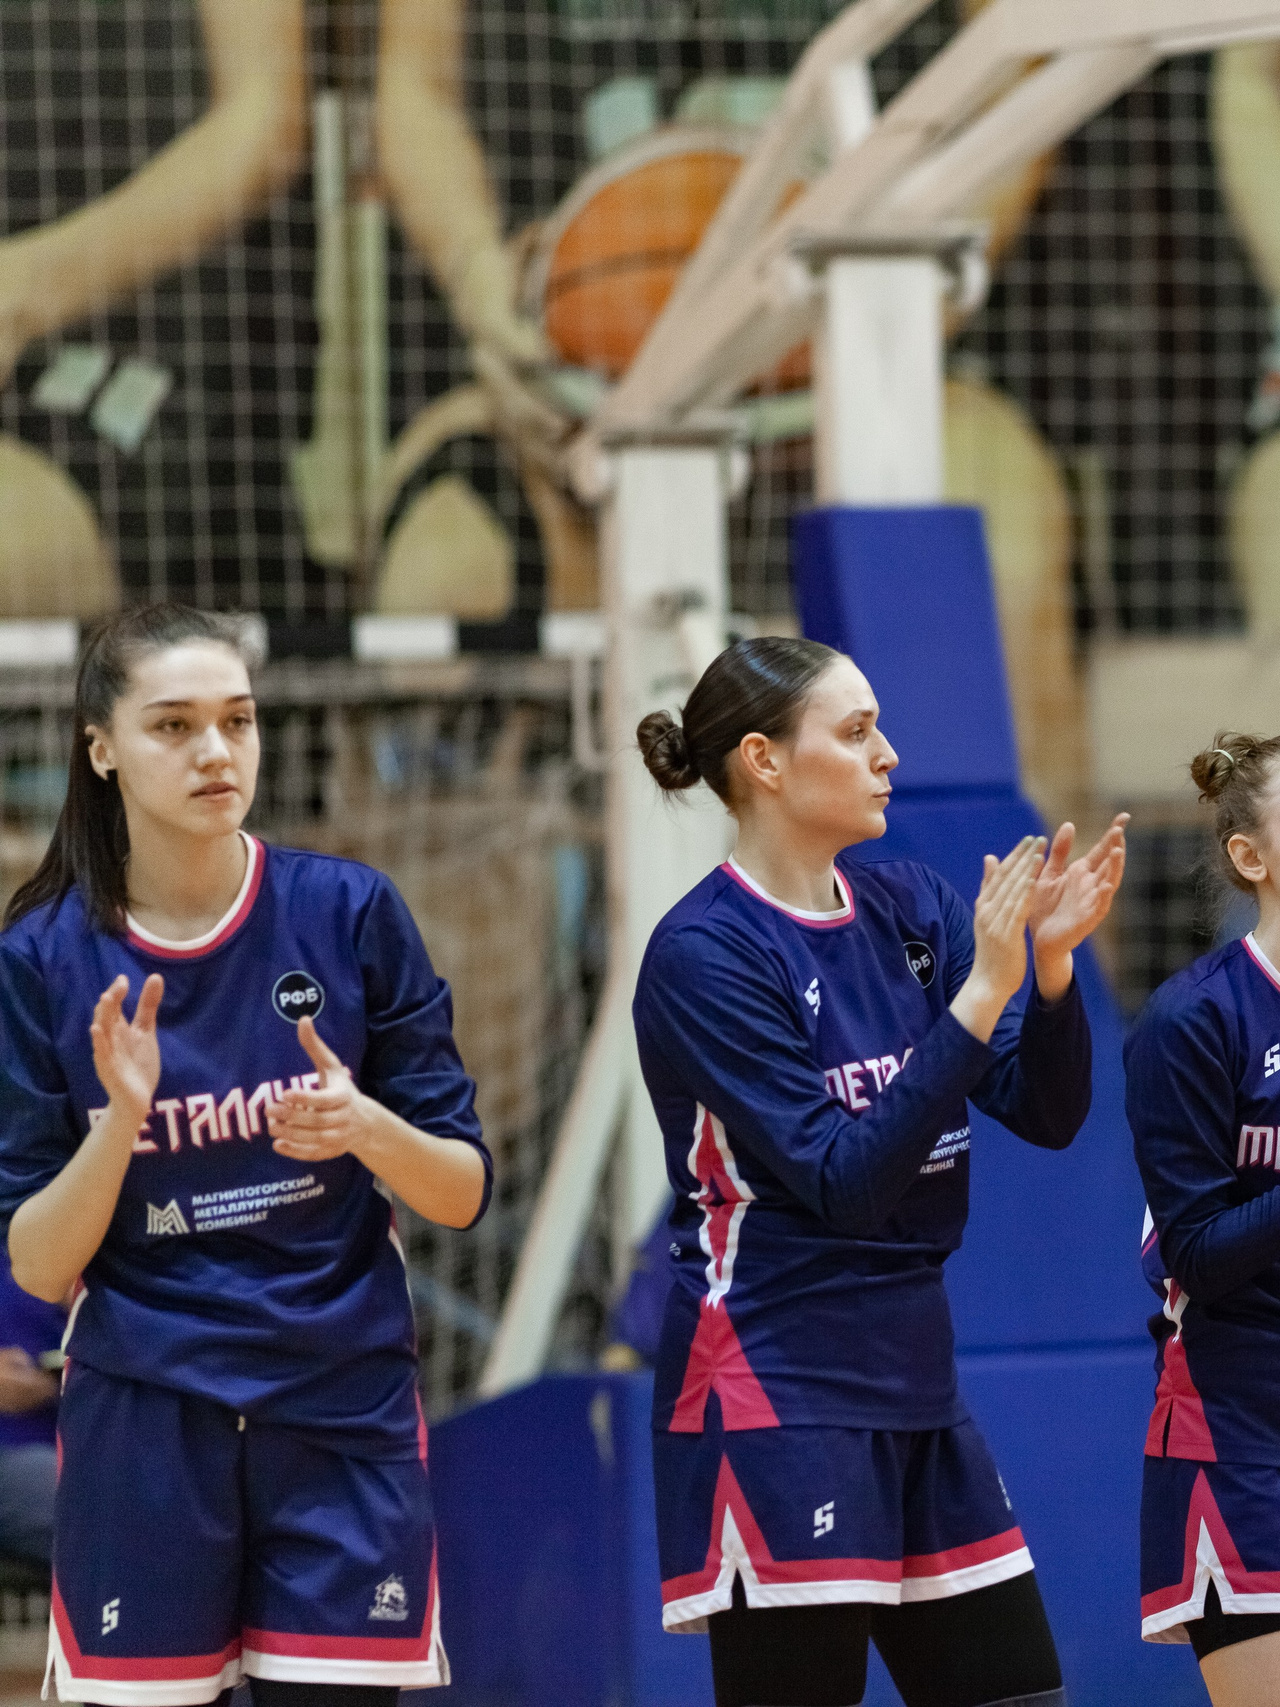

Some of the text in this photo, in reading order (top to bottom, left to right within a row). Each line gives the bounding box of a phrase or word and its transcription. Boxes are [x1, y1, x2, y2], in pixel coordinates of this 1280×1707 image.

[279, 986, 318, 1008] РФБ
[191, 1173, 315, 1207] МАГНИТОГОРСКИЙ
[193, 1183, 325, 1220] МЕТАЛЛУРГИЧЕСКИЙ
[195, 1209, 269, 1233] КОМБИНАТ
